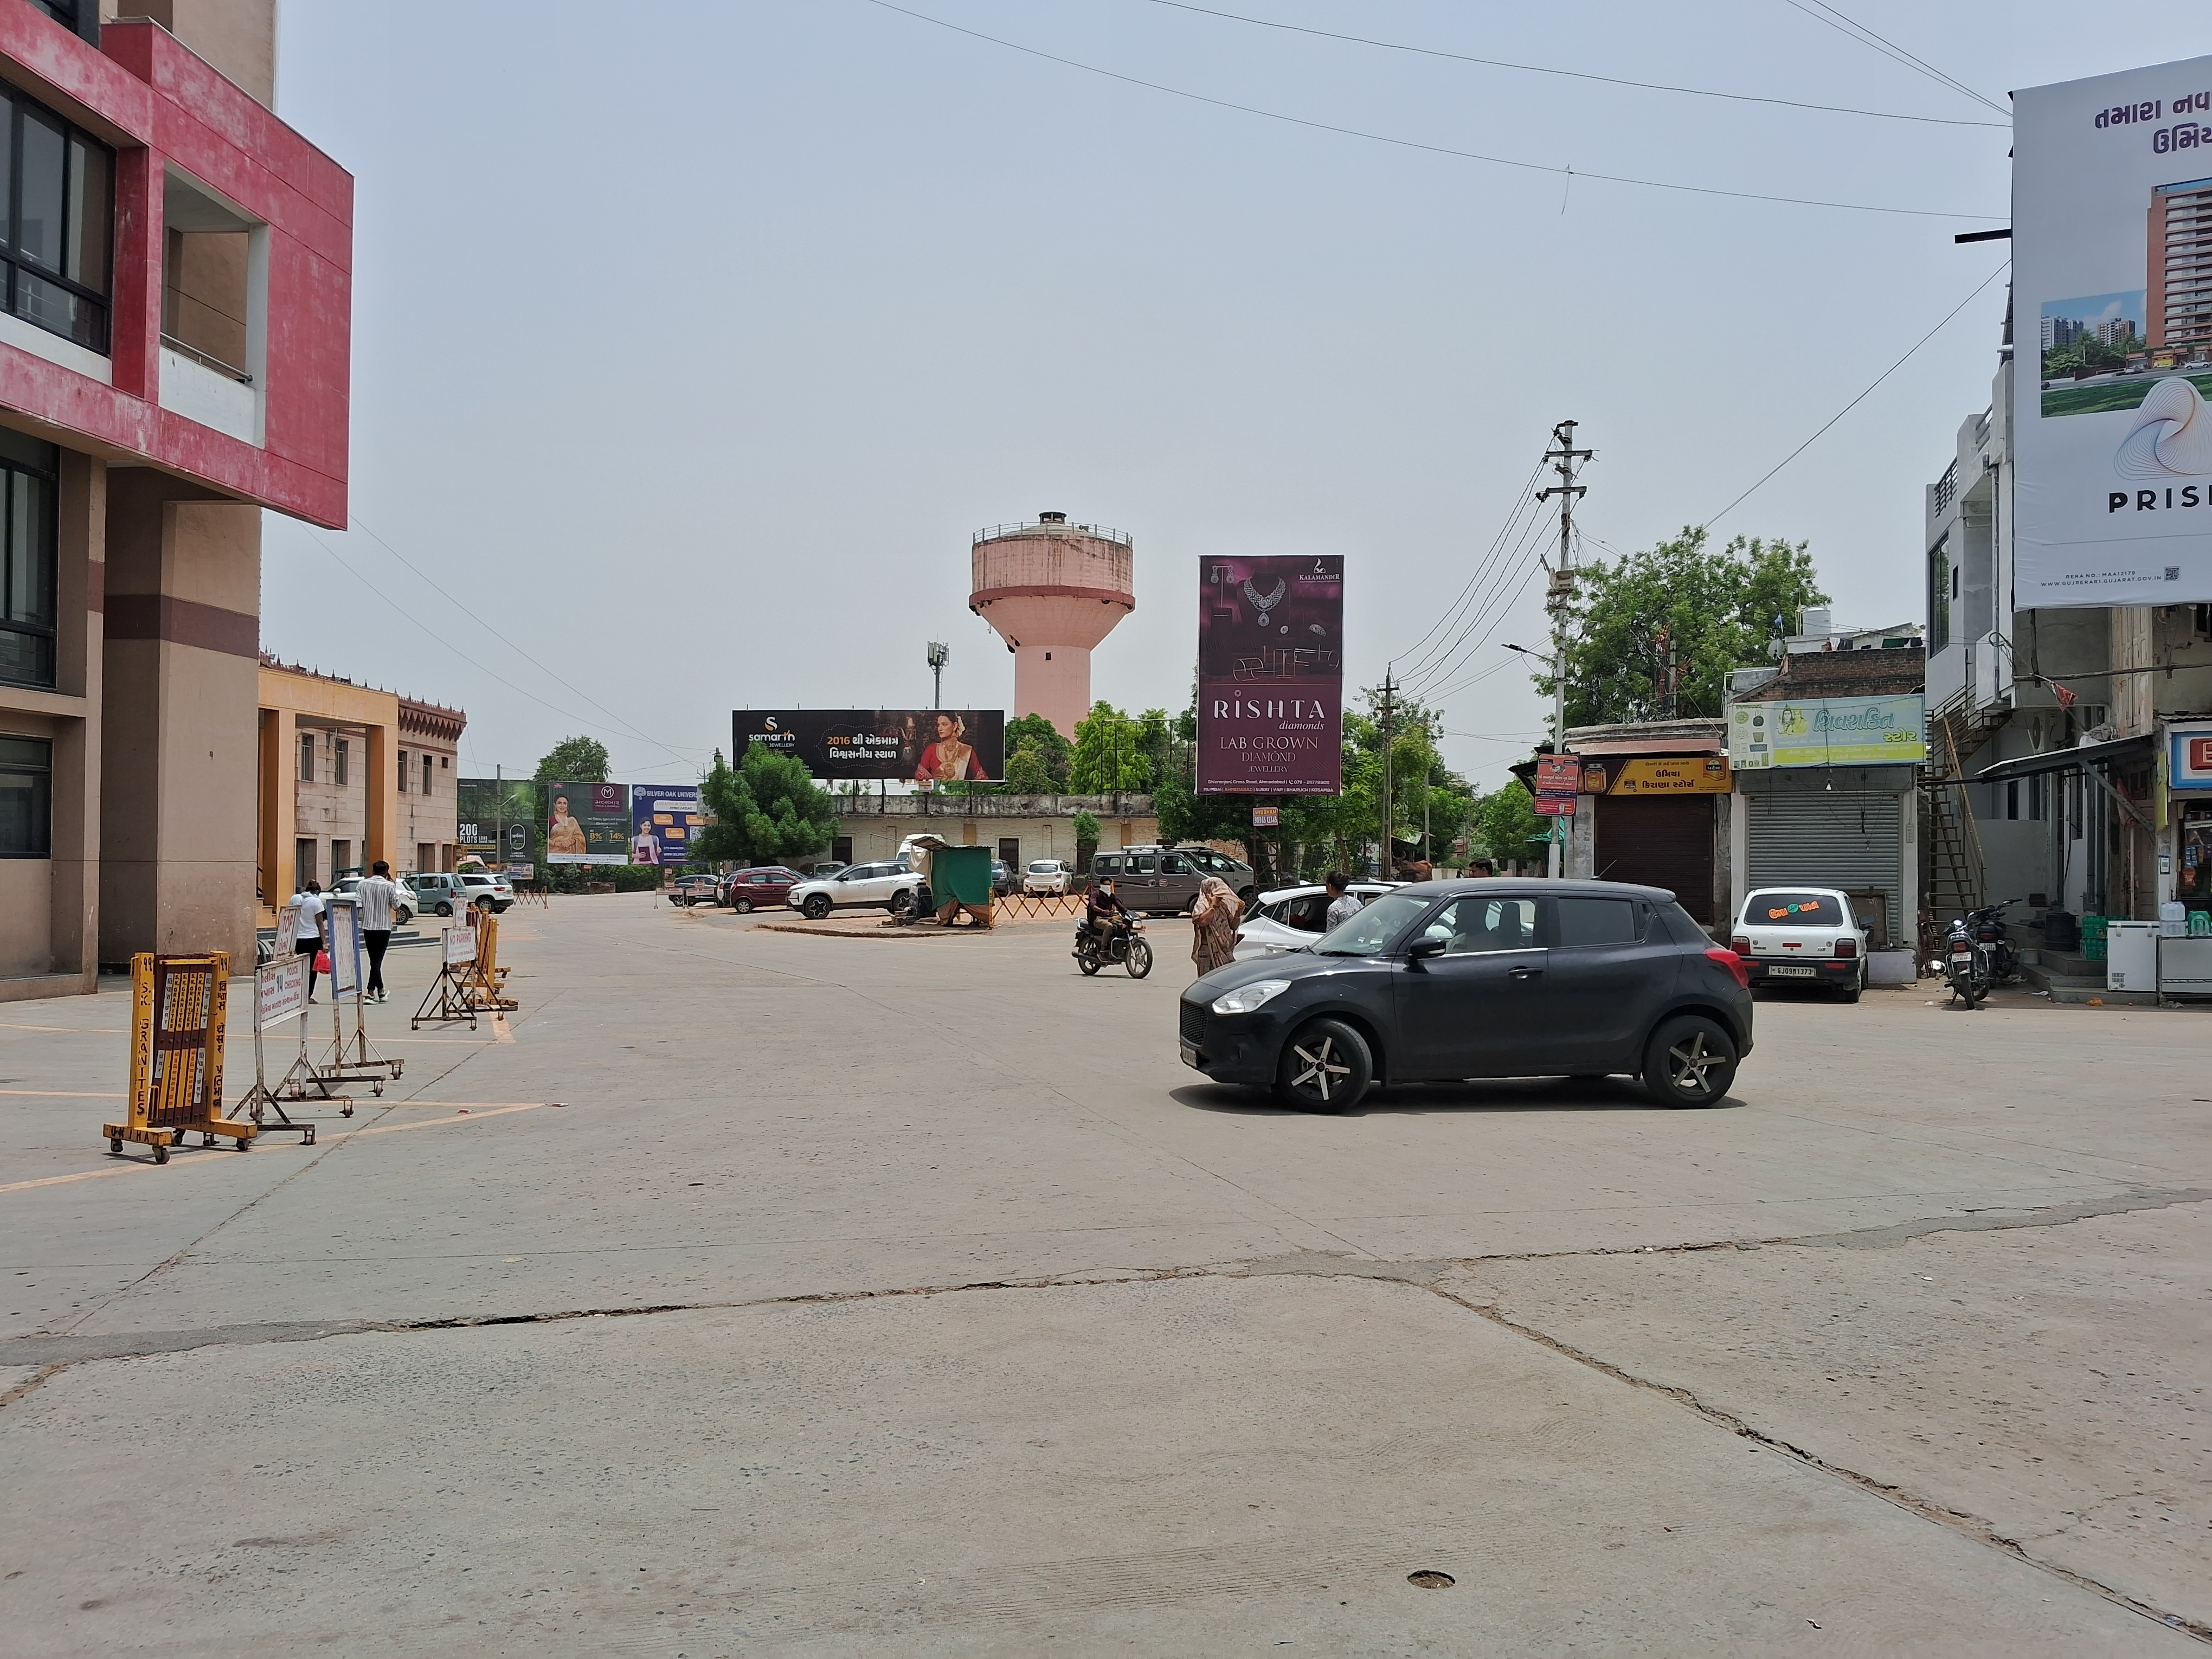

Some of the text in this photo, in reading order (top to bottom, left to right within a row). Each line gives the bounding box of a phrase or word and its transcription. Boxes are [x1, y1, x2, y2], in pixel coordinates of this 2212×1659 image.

[2108, 485, 2212, 513] PRIS
[1279, 721, 1325, 730] diamonds
[827, 736, 850, 745] 2016
[1883, 728, 1917, 743] સ્ટોર
[1220, 736, 1319, 750] LAB GROWN
[1242, 751, 1296, 762] DIAMOND
[1656, 769, 1680, 777] ઉમિયા
[1642, 780, 1669, 788] કિરાણા
[1673, 779, 1695, 788] સ્ટોર્સ
[460, 835, 478, 844] PLOTS
[449, 933, 472, 946] NO PARKING
[287, 965, 298, 976] POLICE
[284, 978, 301, 990] CHECKING
[170, 987, 178, 1028] GRANITES
[186, 987, 194, 1027] GRANITES
[137, 1018, 150, 1115] GRANITES
[111, 1126, 150, 1143] UNJHA
